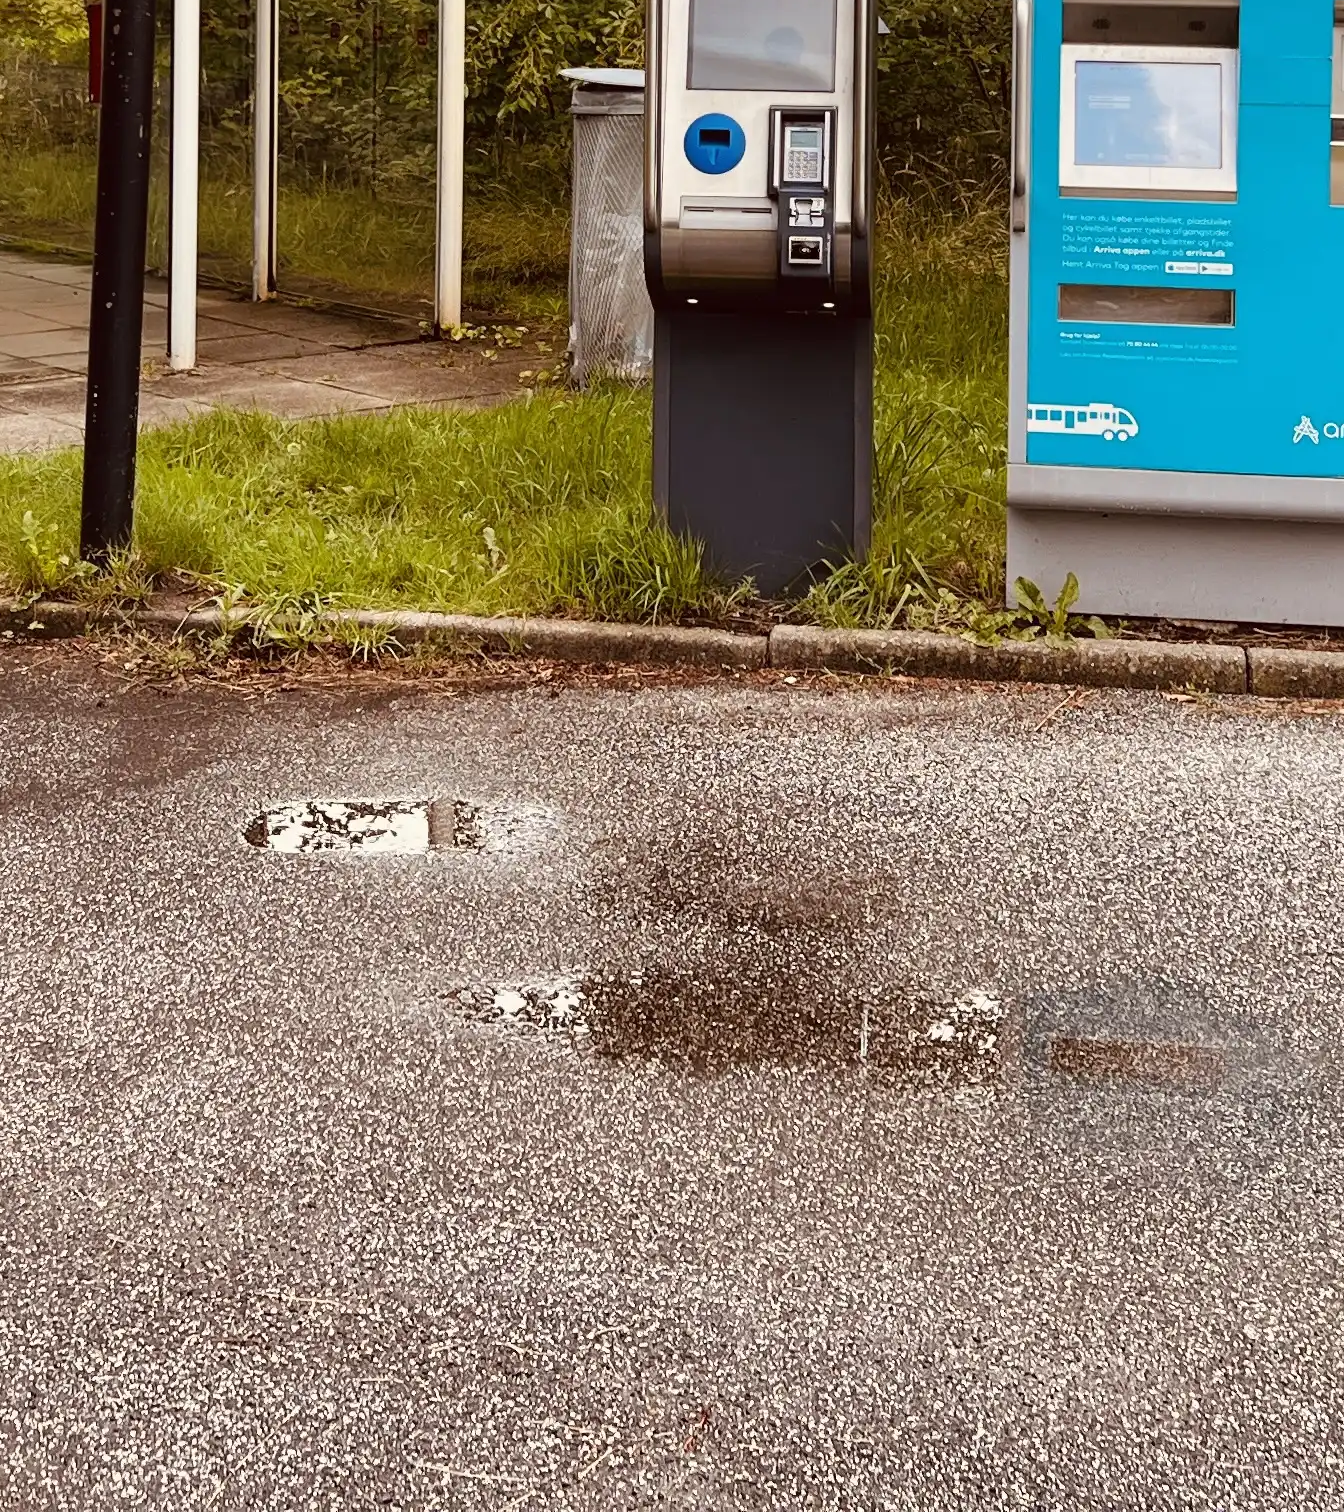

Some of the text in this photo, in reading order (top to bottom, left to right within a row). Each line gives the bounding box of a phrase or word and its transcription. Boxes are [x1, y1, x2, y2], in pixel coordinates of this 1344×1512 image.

[1062, 212, 1078, 221] Her
[1080, 213, 1097, 222] kan
[1098, 214, 1109, 223] du
[1062, 224, 1074, 233] og
[1119, 225, 1142, 234] samt
[1062, 233, 1075, 242] Du
[1077, 234, 1094, 243] kan
[1197, 239, 1209, 248] og
[1093, 245, 1121, 255] Arriva
[1122, 247, 1151, 256] appen
[1185, 249, 1226, 258] arriva.dk
[1085, 260, 1112, 269] Arriva
[1114, 260, 1130, 271] Tog
[1131, 262, 1158, 271] appen
